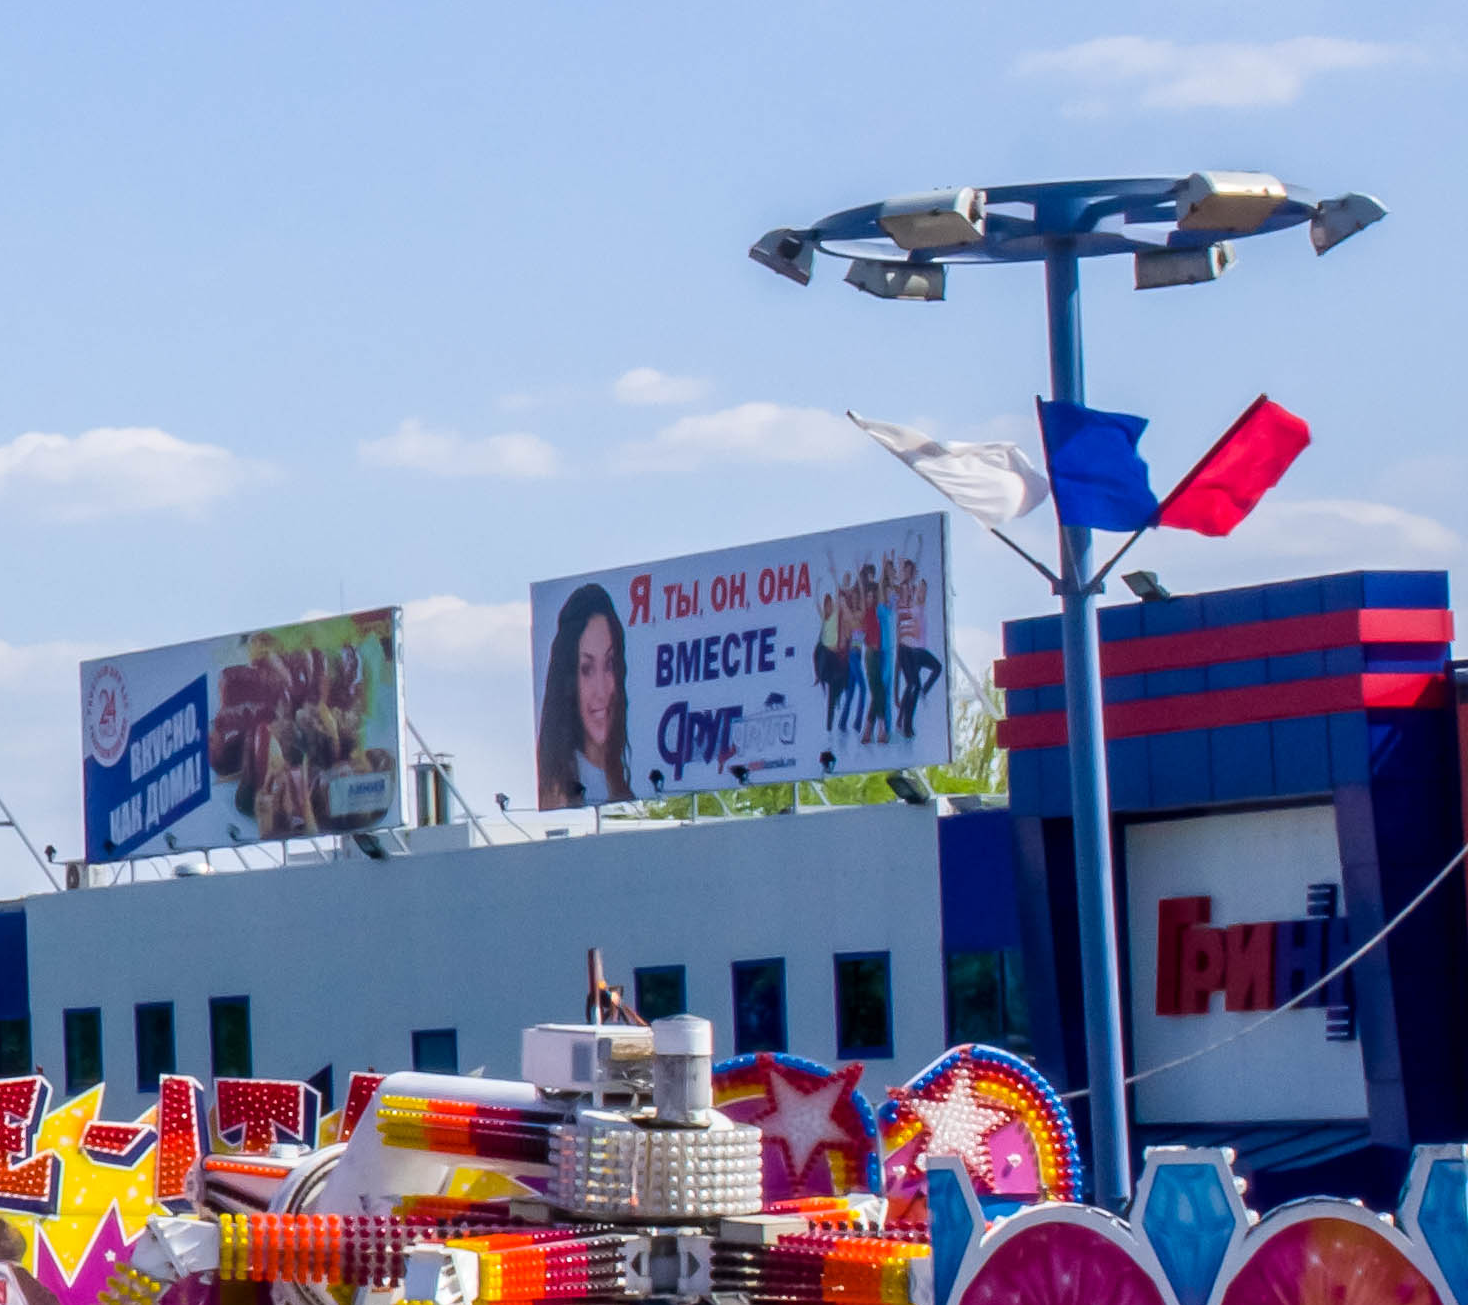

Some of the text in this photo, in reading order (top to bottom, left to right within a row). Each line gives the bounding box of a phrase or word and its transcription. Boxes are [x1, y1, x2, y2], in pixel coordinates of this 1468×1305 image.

[629, 561, 812, 626] Я, ТЫ, ОН, ОНА
[655, 626, 778, 688] ВМЕСТЕ
[129, 701, 201, 783] ВКУСНО,
[109, 750, 203, 846] КАК ДОМА!
